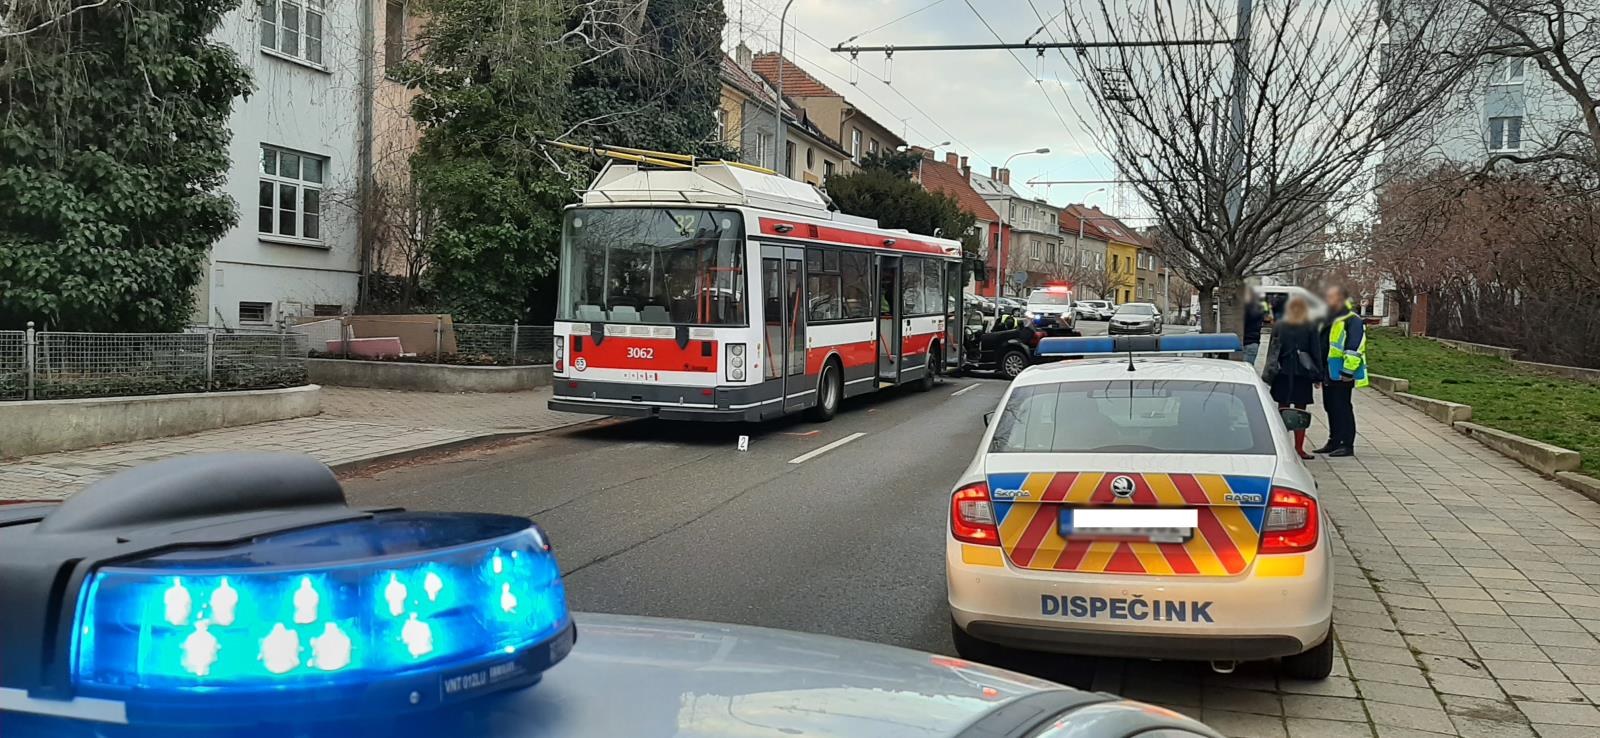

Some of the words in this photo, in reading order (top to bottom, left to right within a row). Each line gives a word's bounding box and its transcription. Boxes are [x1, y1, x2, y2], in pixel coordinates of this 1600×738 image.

[626, 347, 654, 359] 3062
[1223, 493, 1262, 503] RAPID
[1041, 594, 1215, 623] DISPEČINK
